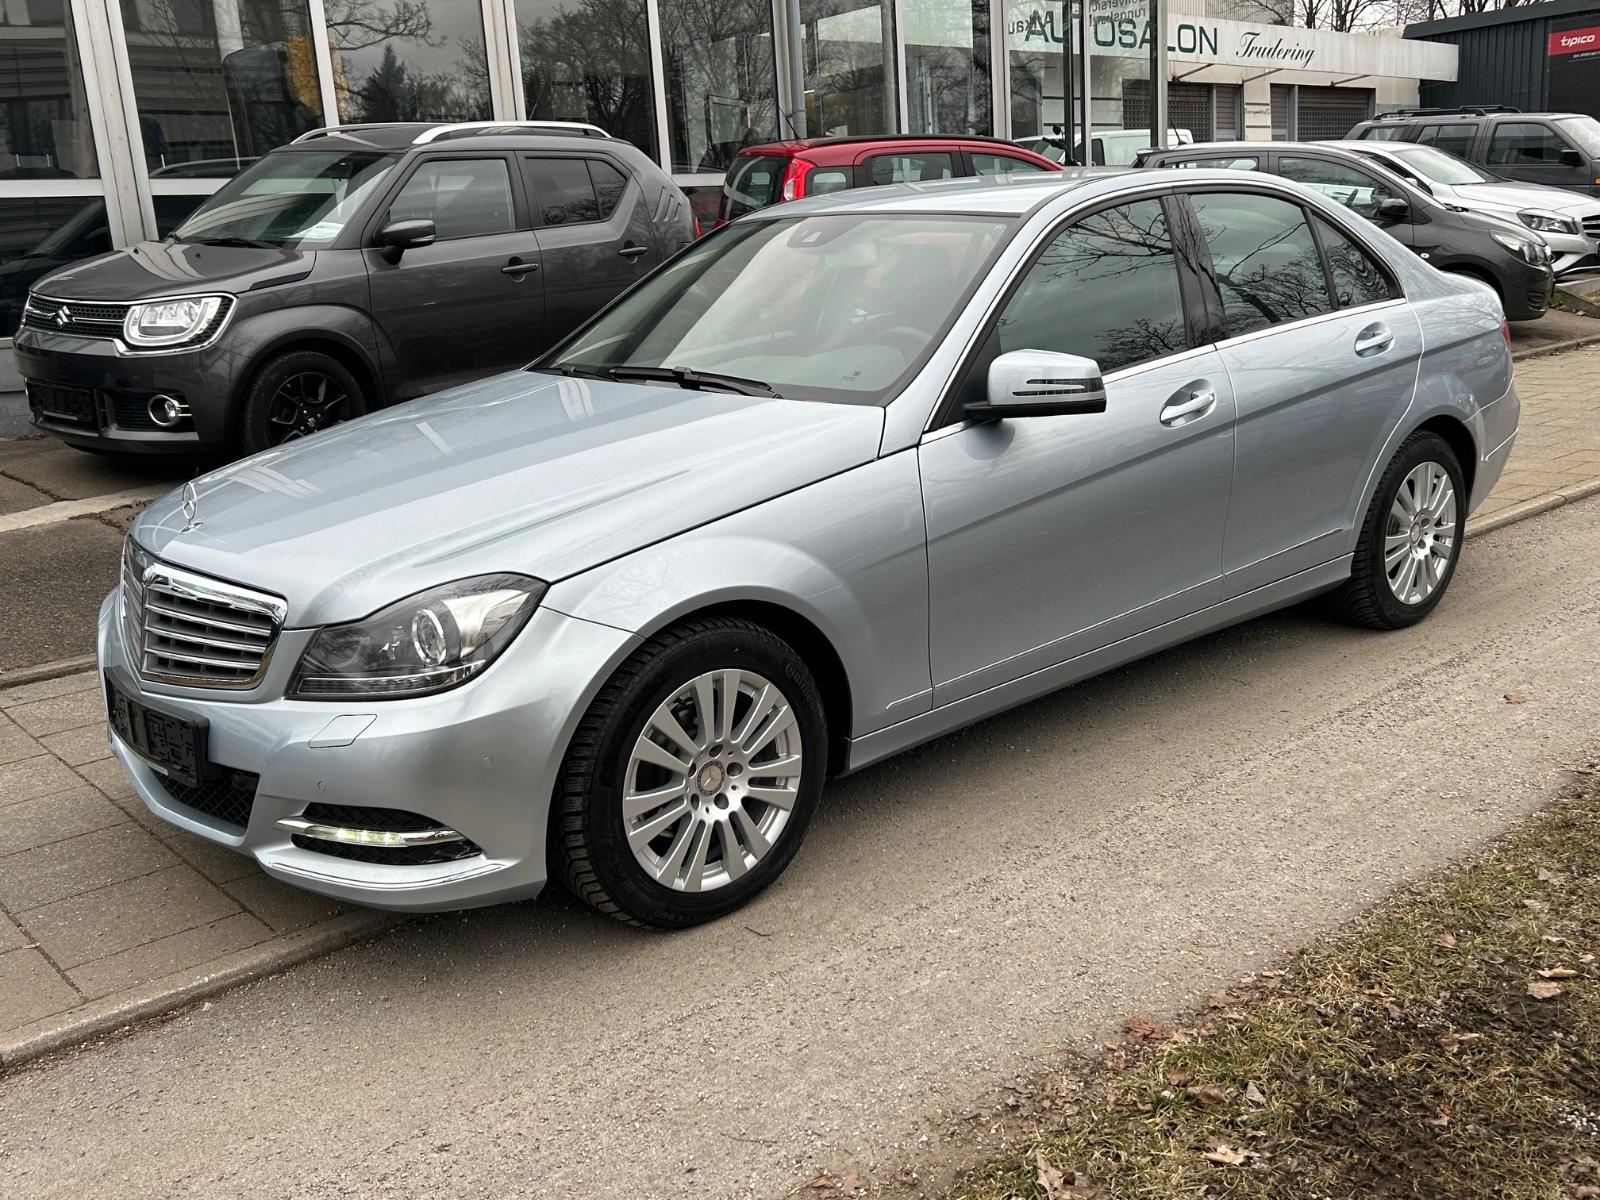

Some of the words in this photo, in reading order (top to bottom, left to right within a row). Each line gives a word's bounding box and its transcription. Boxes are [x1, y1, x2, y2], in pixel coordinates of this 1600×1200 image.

[1024, 10, 1218, 55] AUOSAON
[1236, 31, 1315, 69] Trudering
[1560, 34, 1596, 47] tipico
